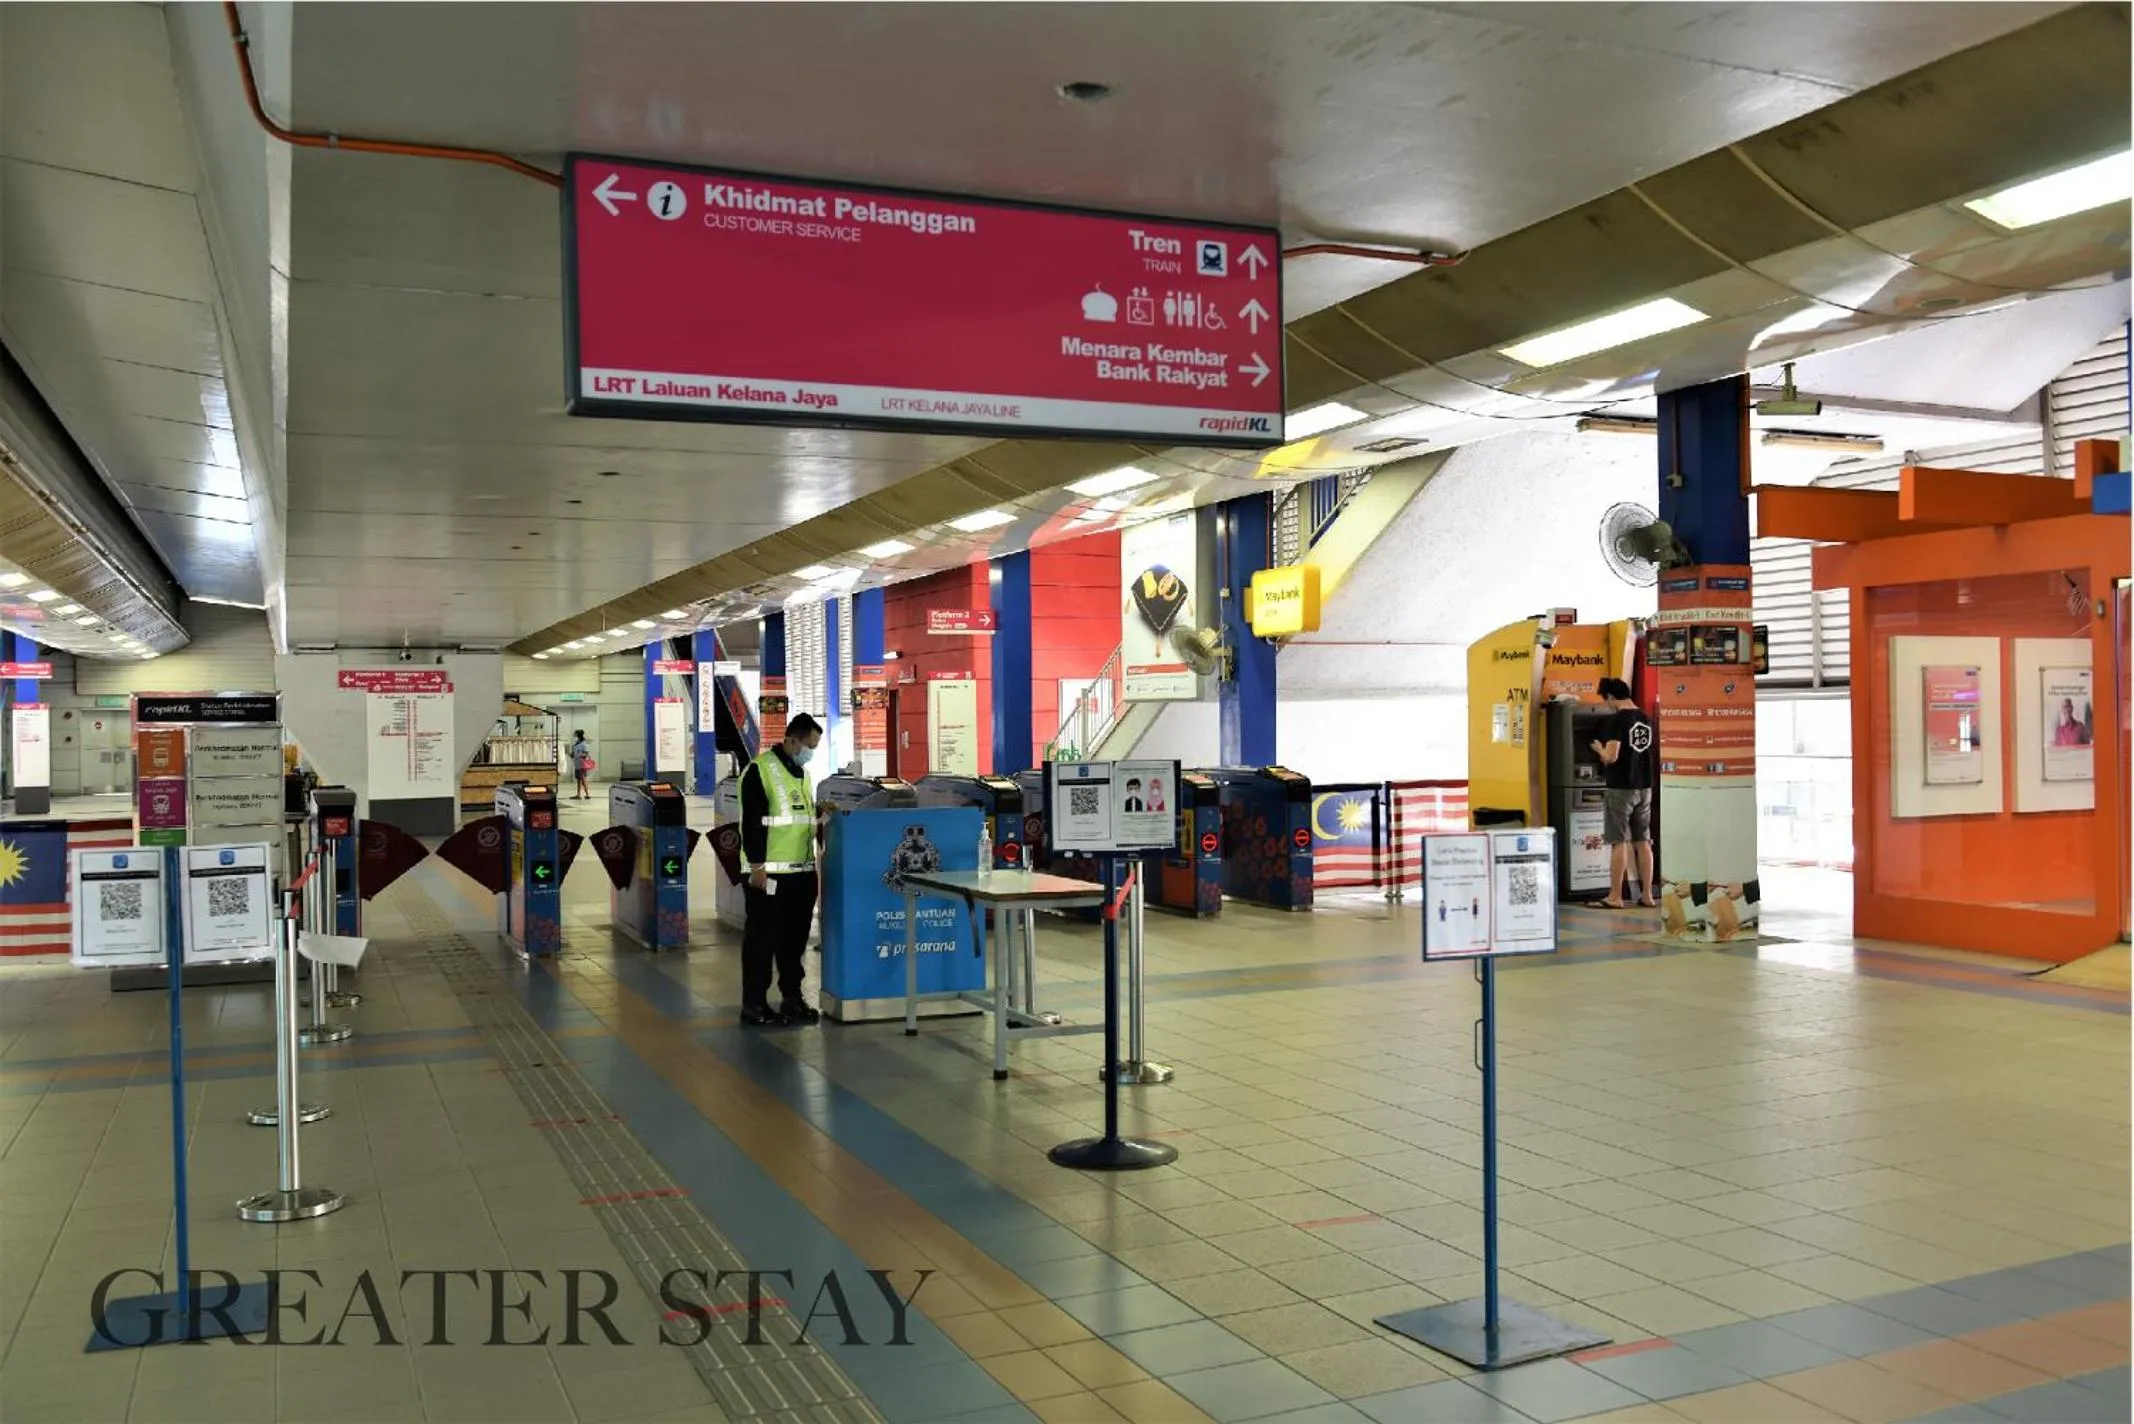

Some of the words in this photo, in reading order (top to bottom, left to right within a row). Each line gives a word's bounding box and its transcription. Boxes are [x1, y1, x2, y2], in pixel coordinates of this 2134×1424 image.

[704, 183, 826, 217] Khidmat
[835, 198, 976, 235] Pelanggan
[704, 213, 793, 237] CUSTOMER
[796, 221, 862, 243] SERVICE
[1128, 230, 1181, 255] Tren
[1143, 258, 1182, 275] TRAIN
[1061, 336, 1141, 361] Menara
[1148, 343, 1228, 368] Kembar
[1097, 360, 1151, 382] Bank
[1156, 364, 1228, 389] Rakyat
[593, 375, 636, 394] LRT
[642, 378, 711, 399] Laluan
[717, 383, 787, 404] Kelana
[792, 388, 839, 409] Jaya
[881, 397, 906, 412] LRT
[908, 399, 960, 415] KELANA
[961, 403, 992, 416] JAYA
[992, 405, 1022, 418] LINE
[1199, 416, 1273, 434] rapidKL
[1551, 653, 1604, 667] Maybank
[1507, 688, 1529, 701] ATM
[875, 911, 906, 921] POLIS
[913, 908, 956, 919] ANTUAN
[893, 941, 956, 957] prsarana
